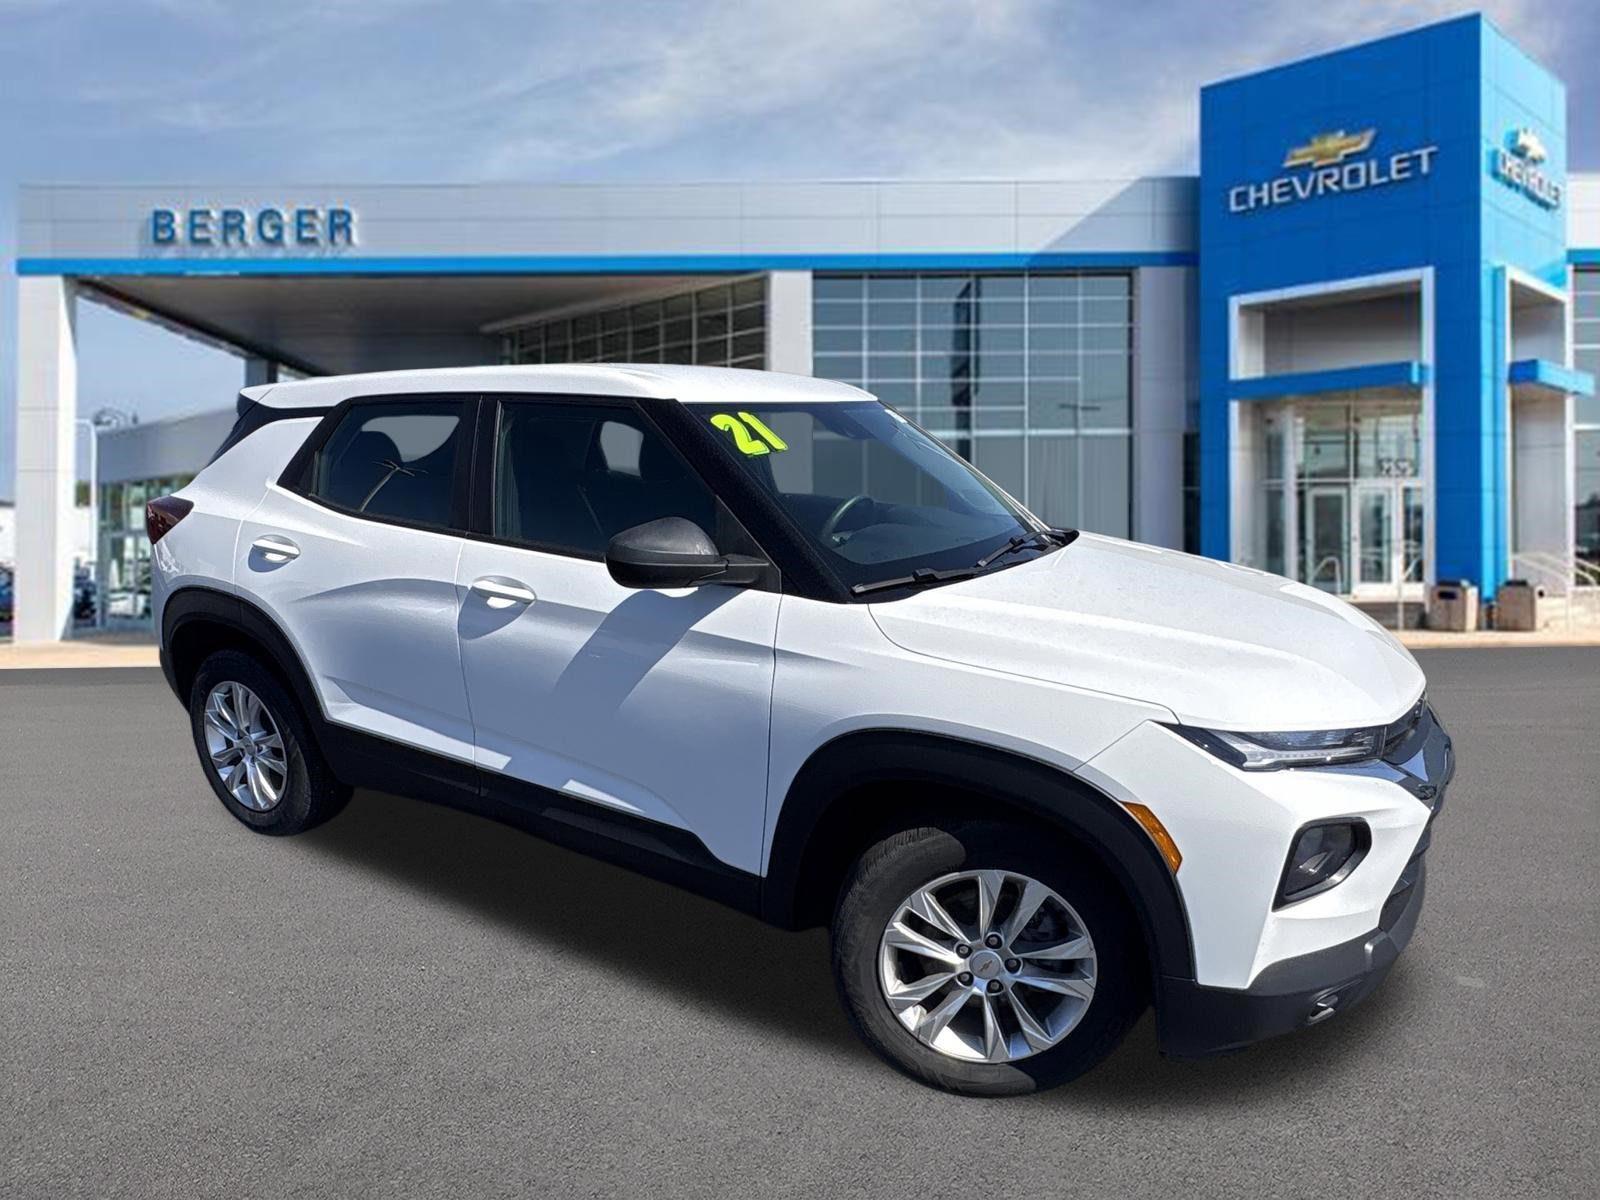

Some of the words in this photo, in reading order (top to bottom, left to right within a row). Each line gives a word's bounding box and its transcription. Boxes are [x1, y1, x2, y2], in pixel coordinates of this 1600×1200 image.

[1229, 146, 1438, 213] CHEVROLET
[152, 208, 355, 245] BERGER
[710, 411, 788, 456] 21
